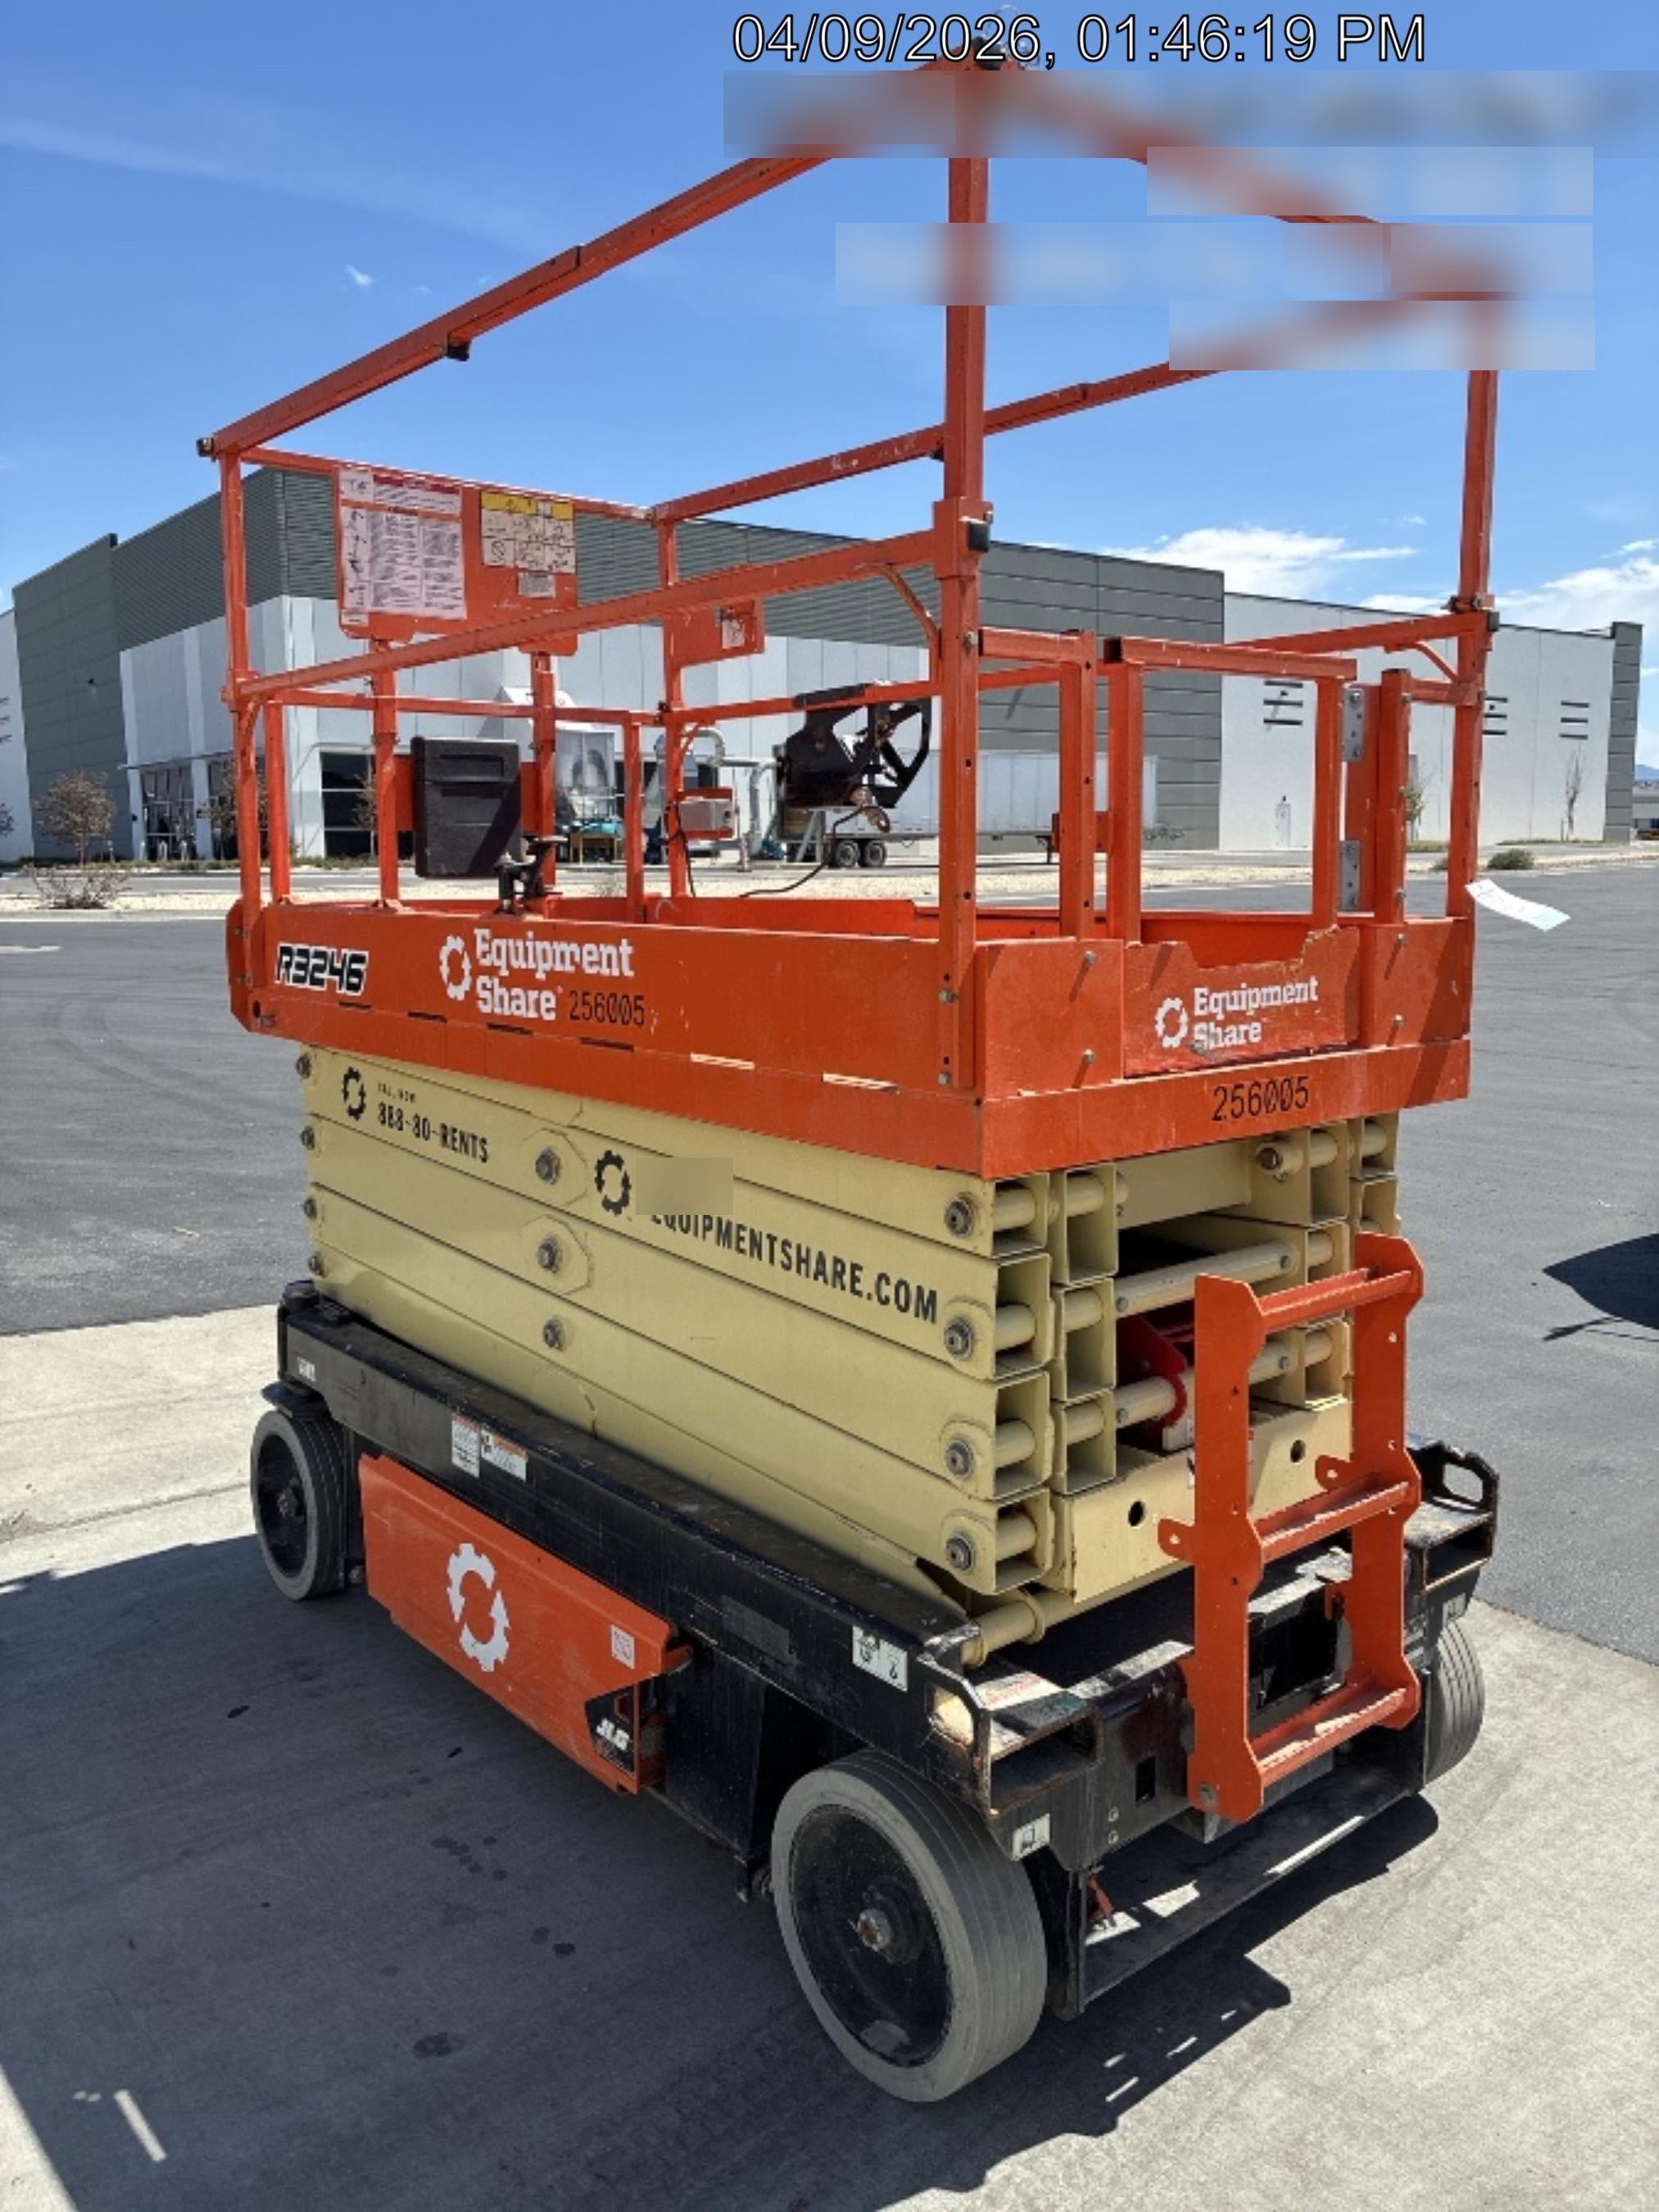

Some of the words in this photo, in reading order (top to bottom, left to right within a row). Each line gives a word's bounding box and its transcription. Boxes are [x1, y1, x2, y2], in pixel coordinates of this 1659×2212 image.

[275, 941, 369, 996] R3246
[474, 928, 634, 977] Equipment
[476, 976, 556, 1021] Share
[569, 990, 646, 1027] 256005
[1193, 975, 1318, 1020] Equipment
[1193, 1021, 1262, 1050] Share
[1211, 1076, 1309, 1122] 256005
